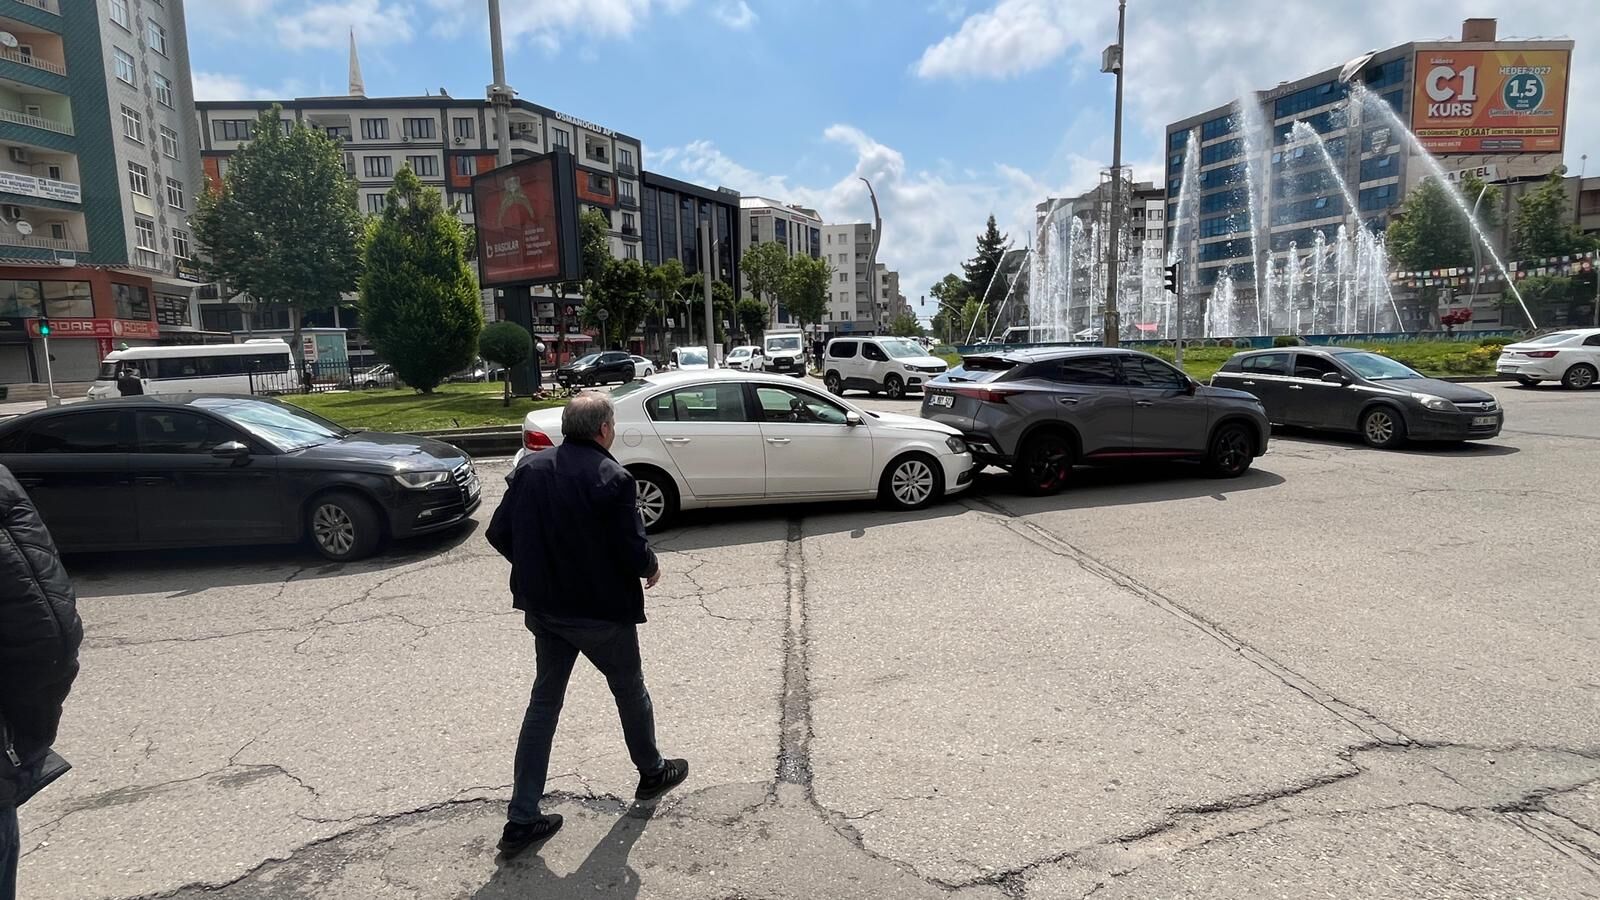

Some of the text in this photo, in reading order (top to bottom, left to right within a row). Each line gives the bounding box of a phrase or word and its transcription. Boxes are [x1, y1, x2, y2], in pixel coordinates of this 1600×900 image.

[1499, 66, 1552, 75] HEDEF 2027
[1425, 65, 1477, 102] C1
[1509, 79, 1538, 98] 1,5
[1428, 102, 1473, 118] KURS
[1460, 128, 1470, 136] 20
[1471, 128, 1490, 136] SAAT
